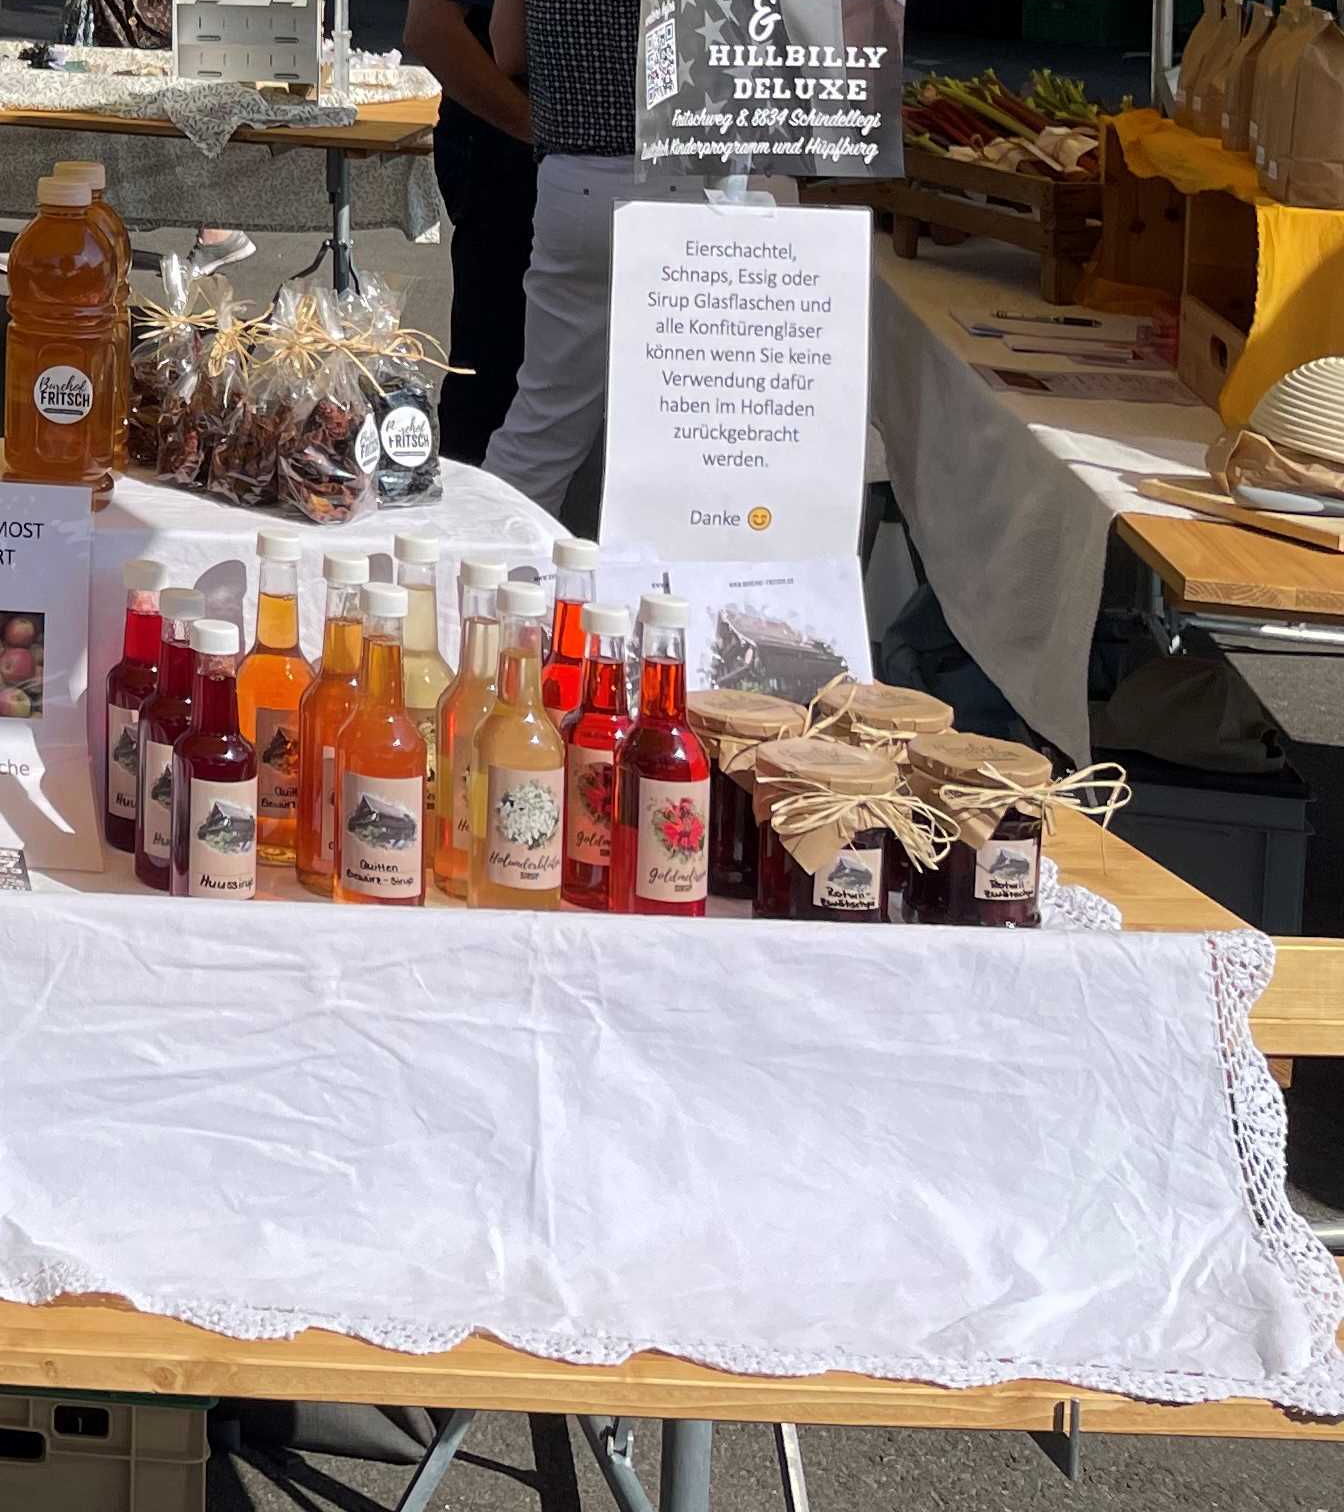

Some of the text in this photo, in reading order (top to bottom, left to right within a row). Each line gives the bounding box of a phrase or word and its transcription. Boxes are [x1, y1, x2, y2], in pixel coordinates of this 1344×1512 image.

[707, 45, 888, 69] HILLBILLY
[733, 78, 867, 101] DELUXE
[751, 108, 786, 127] 8834
[789, 109, 882, 135] Schindellegi
[671, 136, 770, 162] Kinderprogramm
[772, 137, 802, 155] und
[804, 138, 879, 164] Hüpfburg
[685, 240, 797, 261] Eierschachtel,
[661, 266, 819, 288] Schnaps, Essig oder
[647, 291, 832, 313] Sirup Glasflaschen und
[656, 318, 823, 341] alle Konfitürengläser
[646, 343, 832, 366] können wenn Sie keine
[661, 370, 815, 393] Verwendung dafür
[40, 391, 90, 407] FRITSCH
[660, 396, 815, 417] haben im Hofladen
[388, 434, 429, 448] FRITSCH
[673, 422, 800, 444] zurückgebracht
[702, 451, 769, 468] werden.
[690, 510, 740, 527] Danke
